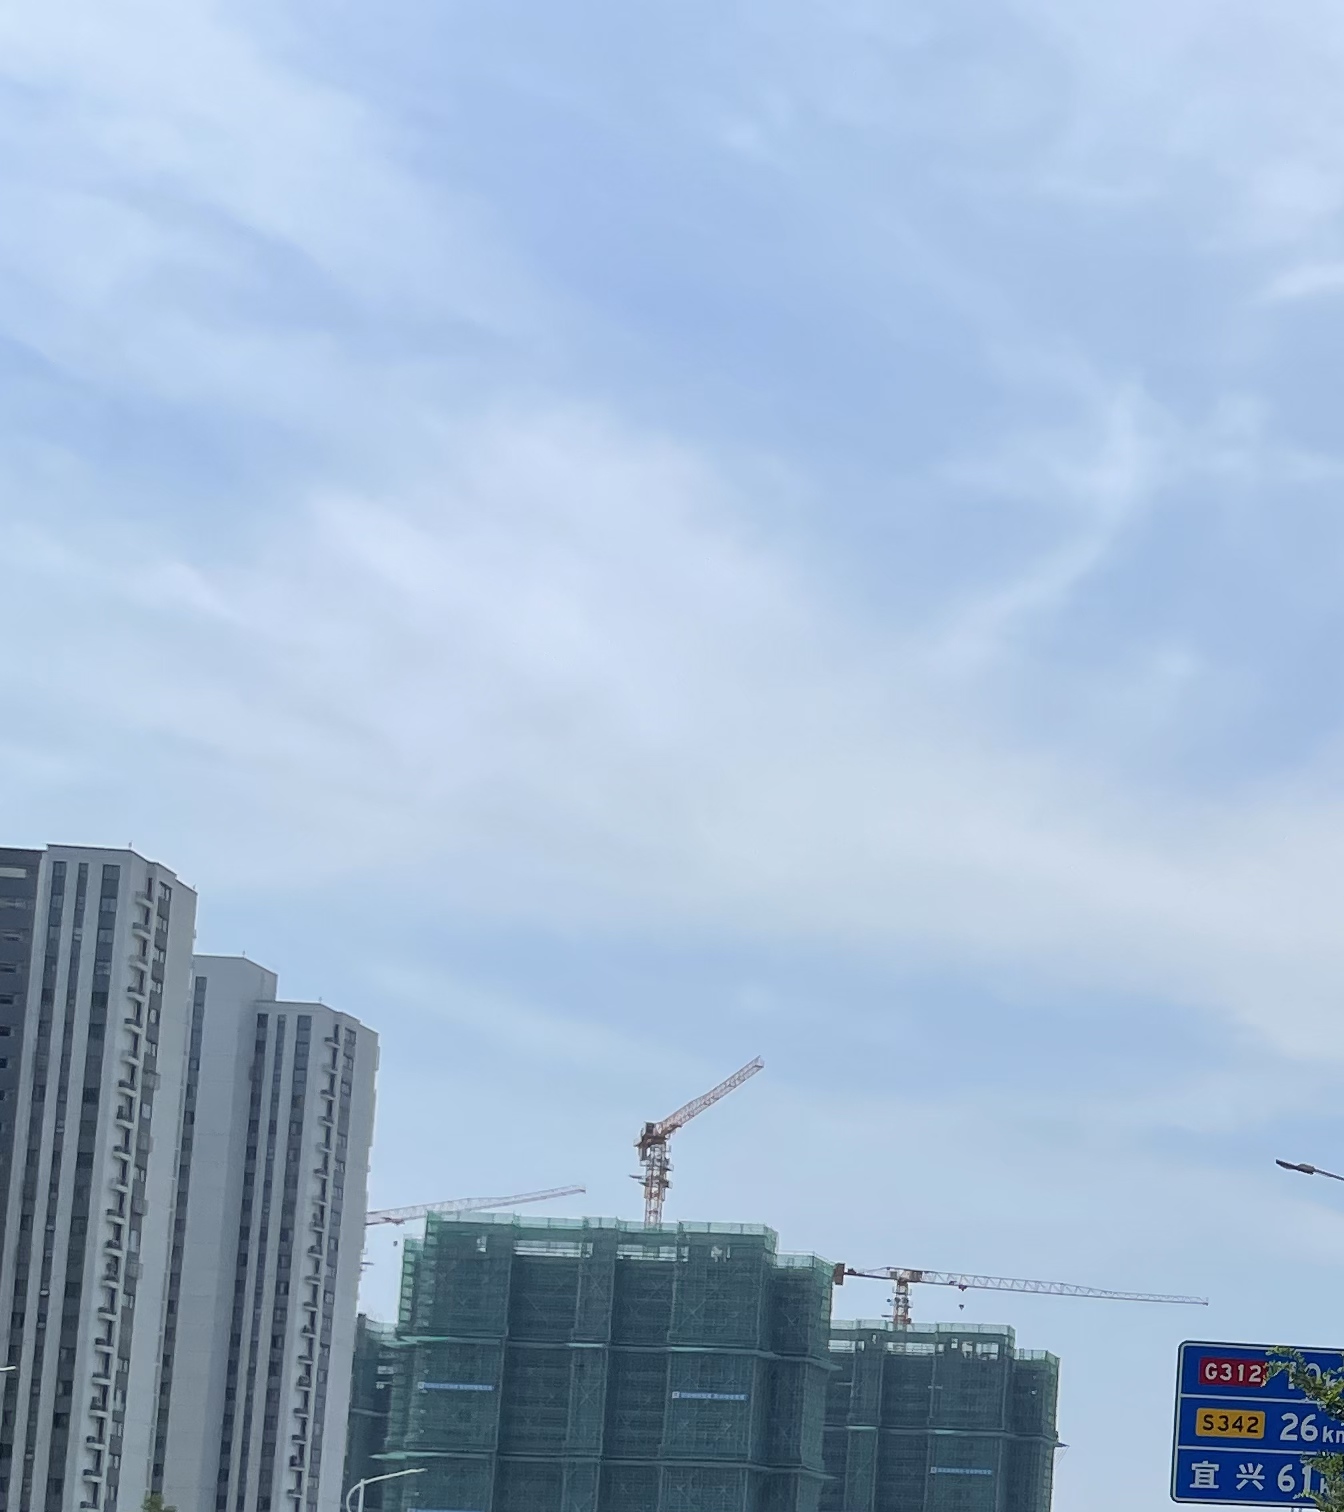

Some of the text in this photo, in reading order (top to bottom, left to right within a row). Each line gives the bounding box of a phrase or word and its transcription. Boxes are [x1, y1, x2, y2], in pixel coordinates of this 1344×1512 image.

[1205, 1363, 1262, 1384] G312
[1202, 1414, 1260, 1434] S342
[1190, 1461, 1266, 1490] 宜兴
